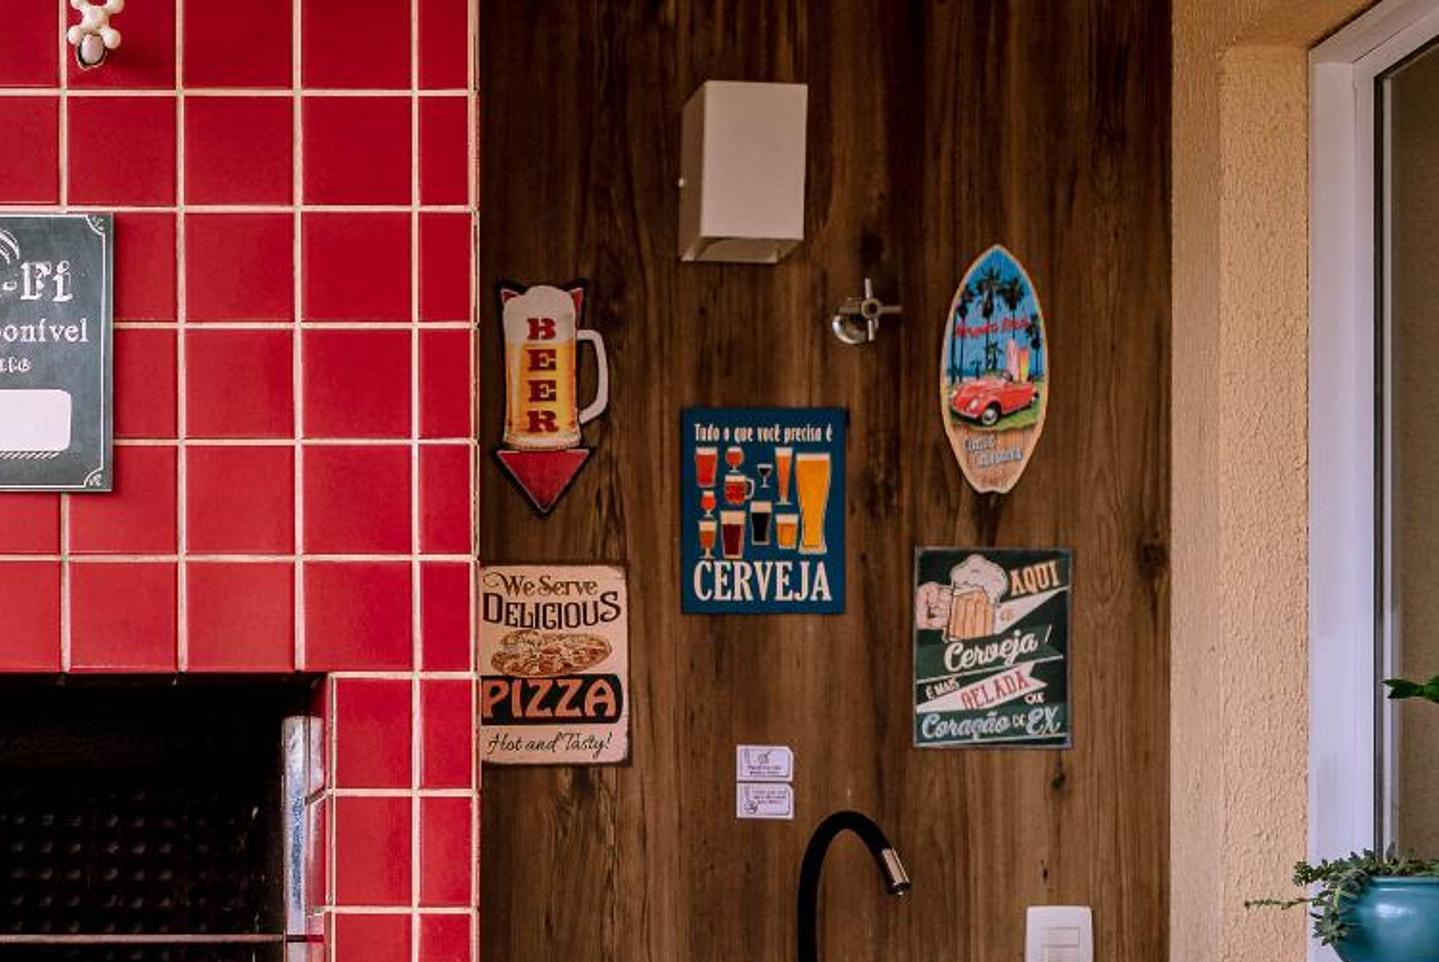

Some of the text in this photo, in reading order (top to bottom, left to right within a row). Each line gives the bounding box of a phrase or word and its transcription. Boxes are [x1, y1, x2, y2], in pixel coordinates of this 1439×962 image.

[526, 317, 559, 433] BEER
[694, 423, 720, 442] Tudo
[734, 427, 753, 444] que
[784, 424, 822, 444] precisa
[483, 571, 598, 596] We Serve
[693, 560, 833, 601] CERVEJA
[1010, 560, 1060, 596] AQUI
[483, 591, 621, 630] DELICIOUS
[944, 629, 1039, 673] Cerveja
[482, 678, 617, 718] PIZZA
[921, 711, 1010, 740] Coração
[488, 732, 613, 759] Hot and Tasty!
